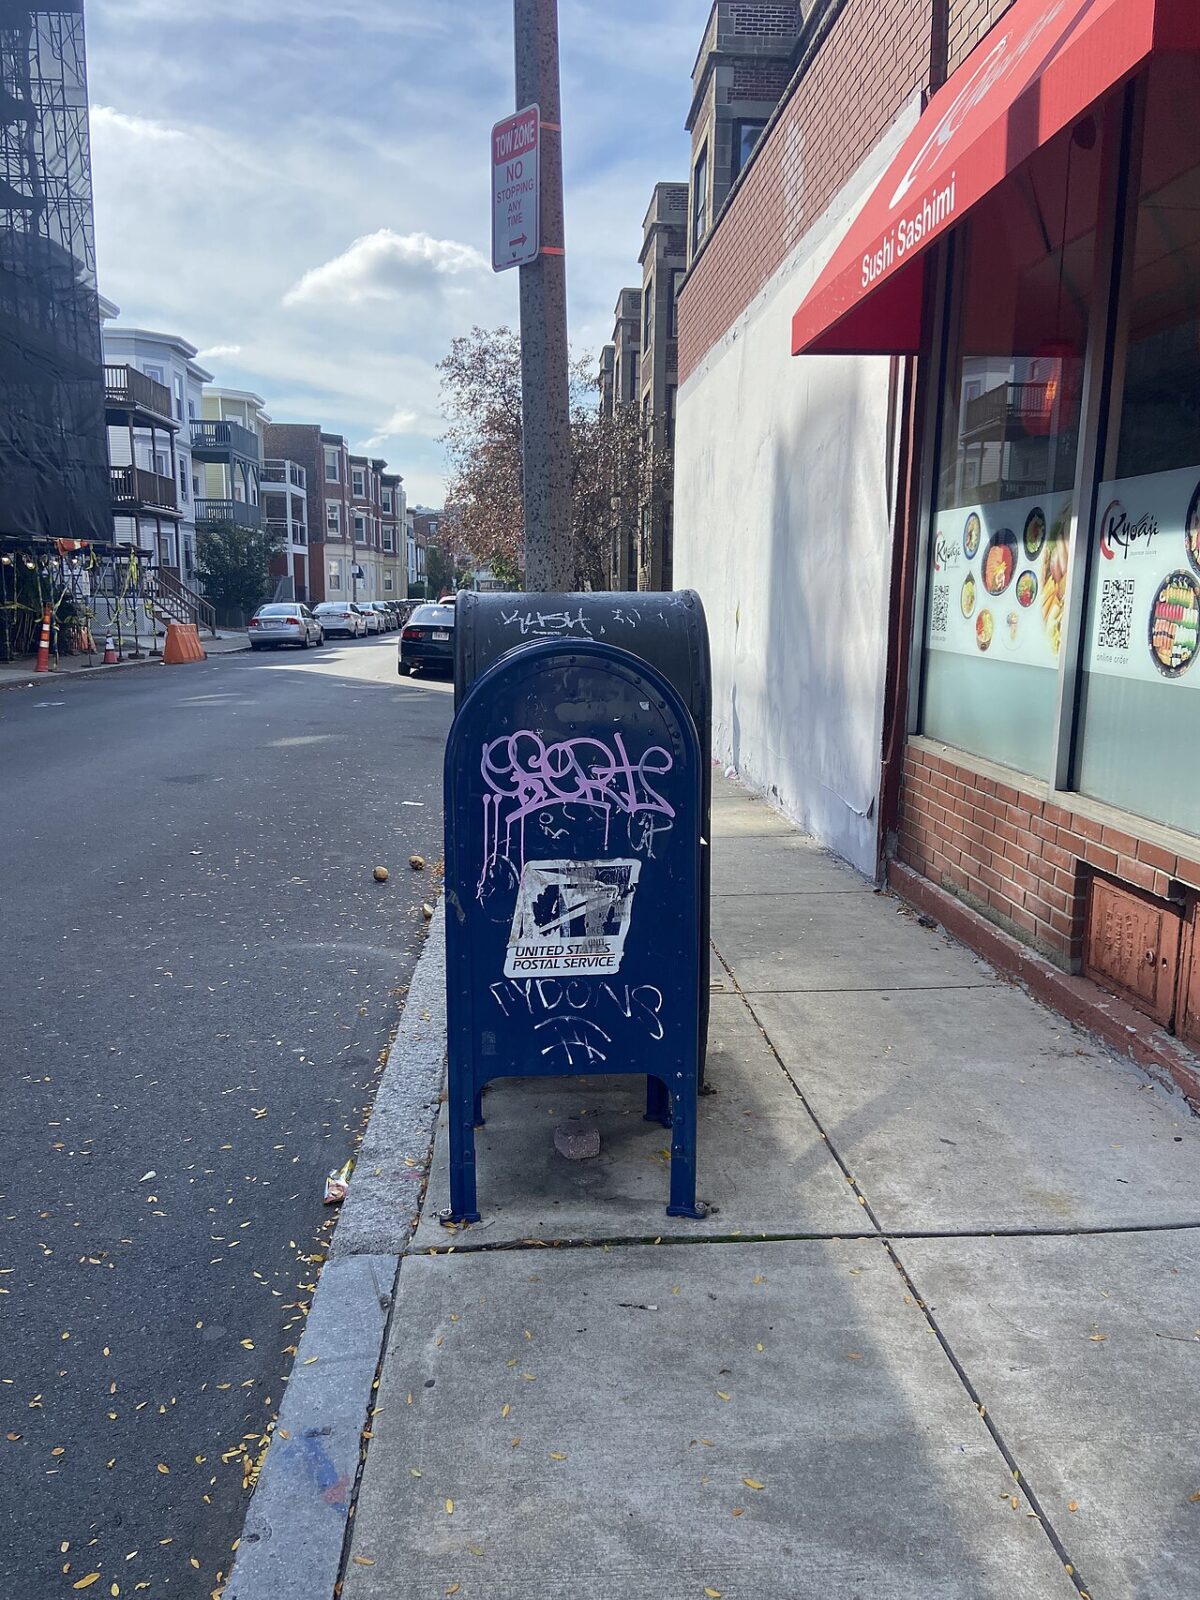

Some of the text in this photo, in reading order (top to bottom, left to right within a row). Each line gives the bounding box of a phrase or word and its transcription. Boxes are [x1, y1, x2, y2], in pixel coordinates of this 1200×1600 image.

[496, 120, 535, 158] TOW ZONE
[506, 161, 523, 183] NO
[496, 178, 534, 204] STOPPING
[507, 199, 522, 214] ANY
[507, 212, 523, 228] TIME
[862, 171, 955, 288] Sushi Sashimi
[515, 943, 611, 957] UNITED STATES
[513, 959, 560, 970] POSTAL
